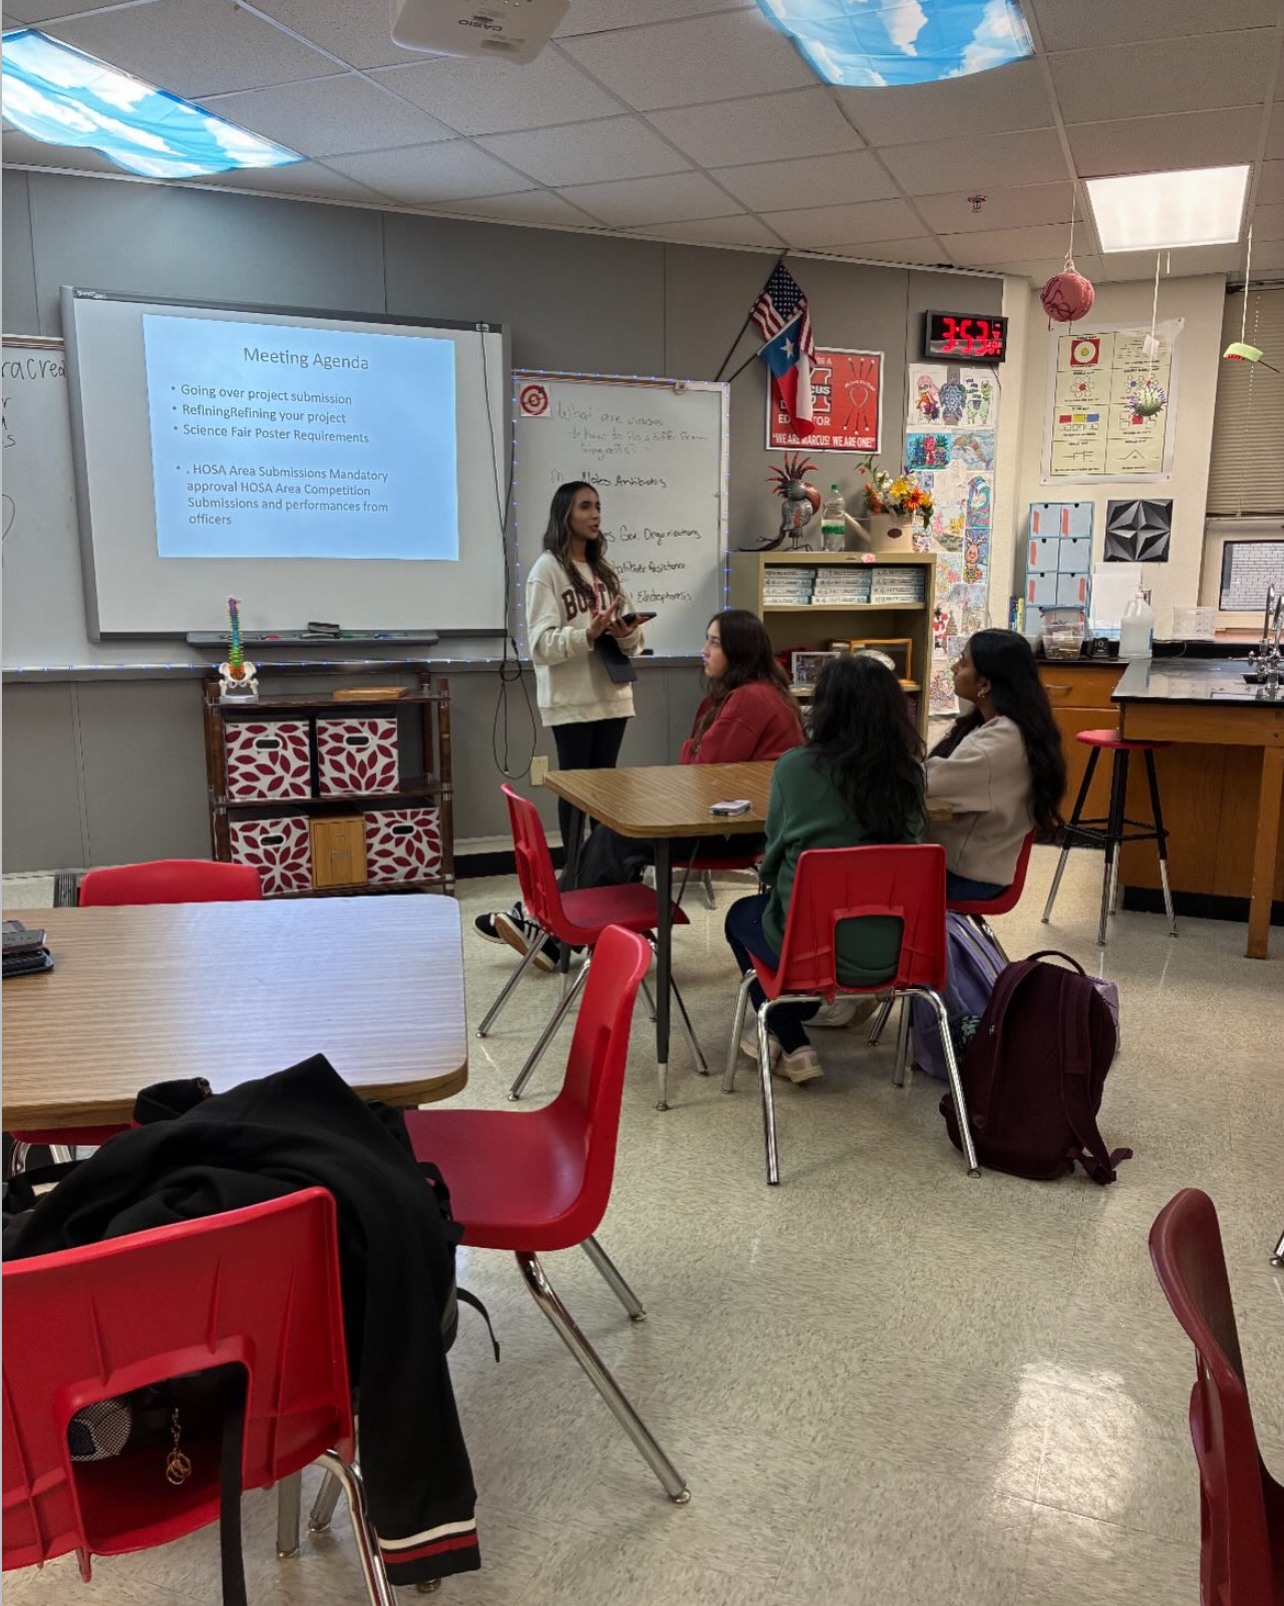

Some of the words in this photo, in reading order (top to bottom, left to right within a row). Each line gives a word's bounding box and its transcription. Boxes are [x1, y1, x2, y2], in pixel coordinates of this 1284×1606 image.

[458, 19, 503, 31] CASIO
[941, 317, 989, 356] 3:53
[243, 347, 309, 368] Meeting
[313, 353, 369, 370] Agenda
[181, 384, 217, 399] Going
[218, 388, 245, 399] over
[248, 389, 288, 403] project
[291, 391, 352, 405] submission
[279, 412, 304, 424] your
[307, 412, 346, 425] project
[183, 424, 228, 437] Science
[231, 426, 252, 438] Fair
[255, 428, 290, 440] Poster
[294, 429, 370, 444] Requirements
[193, 464, 227, 476] HOSA
[229, 465, 256, 477] Area
[259, 466, 327, 479] Submissions
[329, 468, 388, 483] Mandatory
[187, 481, 238, 494] approval
[240, 482, 273, 493] HOSA
[275, 483, 301, 494] Area
[304, 485, 371, 497] Competition
[187, 497, 259, 509] Submissions
[261, 499, 283, 509] and
[285, 500, 361, 512] performances
[363, 501, 388, 512] from
[188, 514, 232, 525] officers
